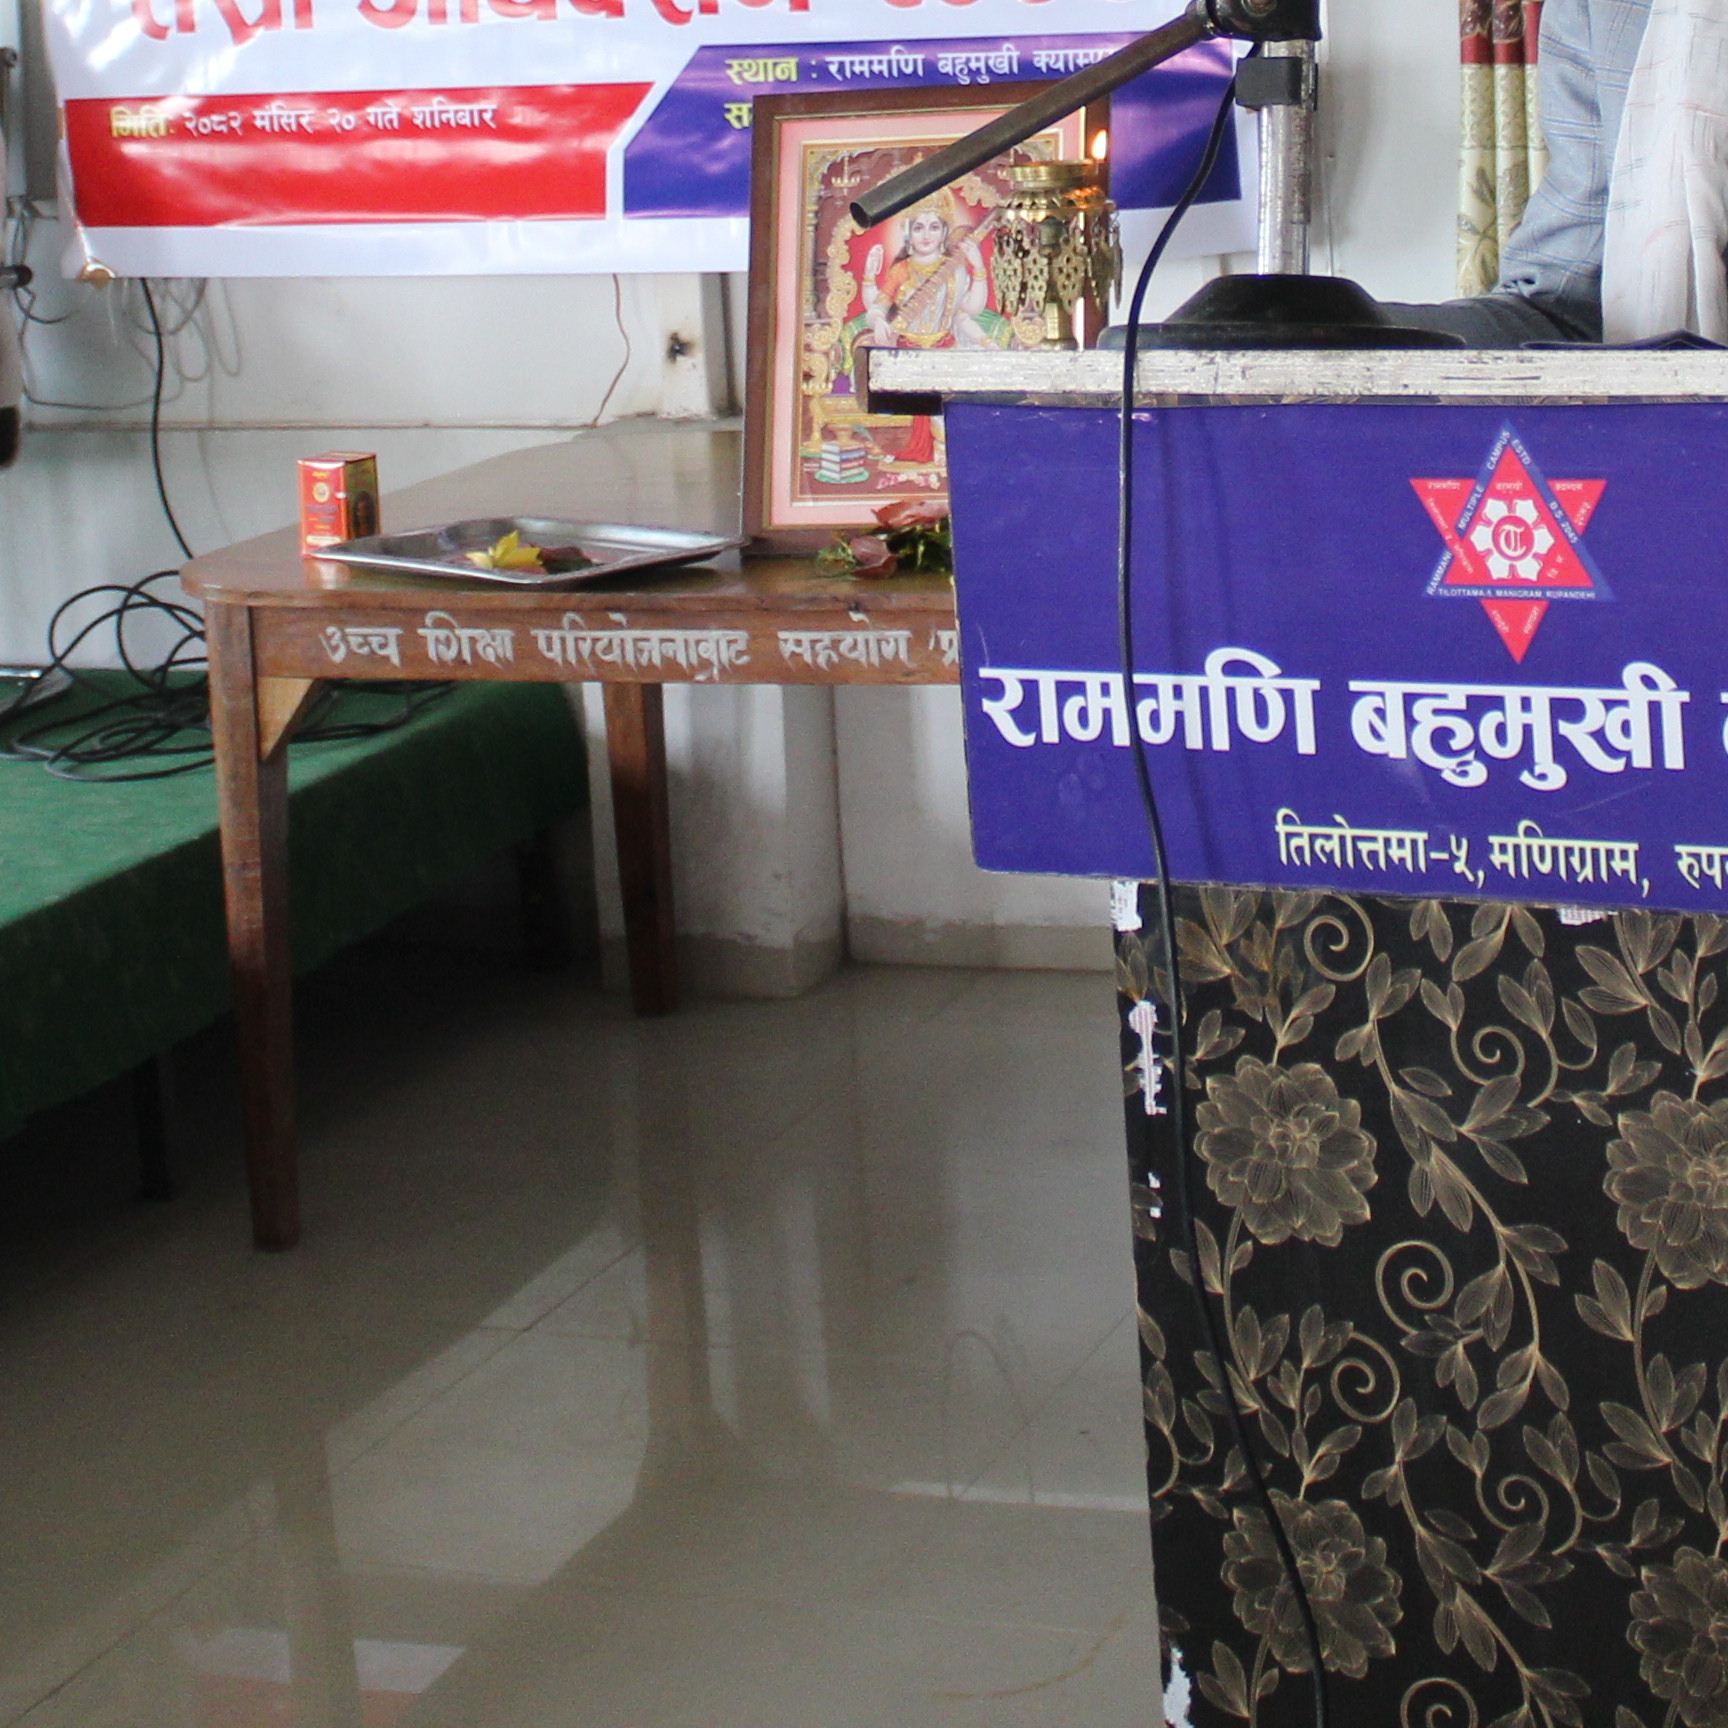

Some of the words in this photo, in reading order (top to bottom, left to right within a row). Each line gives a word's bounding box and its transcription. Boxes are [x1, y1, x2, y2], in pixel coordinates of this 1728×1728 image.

[824, 47, 925, 82] राममणि
[937, 44, 1019, 84] बहुमुखी
[184, 109, 243, 137] २०८२
[253, 101, 314, 135] मंसिर
[327, 108, 356, 133] २०
[367, 101, 400, 131] गते
[1458, 485, 1484, 530] MULTIPLE
[1486, 431, 1511, 471] CAMPUS
[319, 625, 404, 668] उच्च
[417, 610, 515, 669] शिक्षा
[777, 611, 918, 671] सहयोग
[978, 647, 1321, 755] राममणि
[1348, 661, 1690, 791] बहुमुखी
